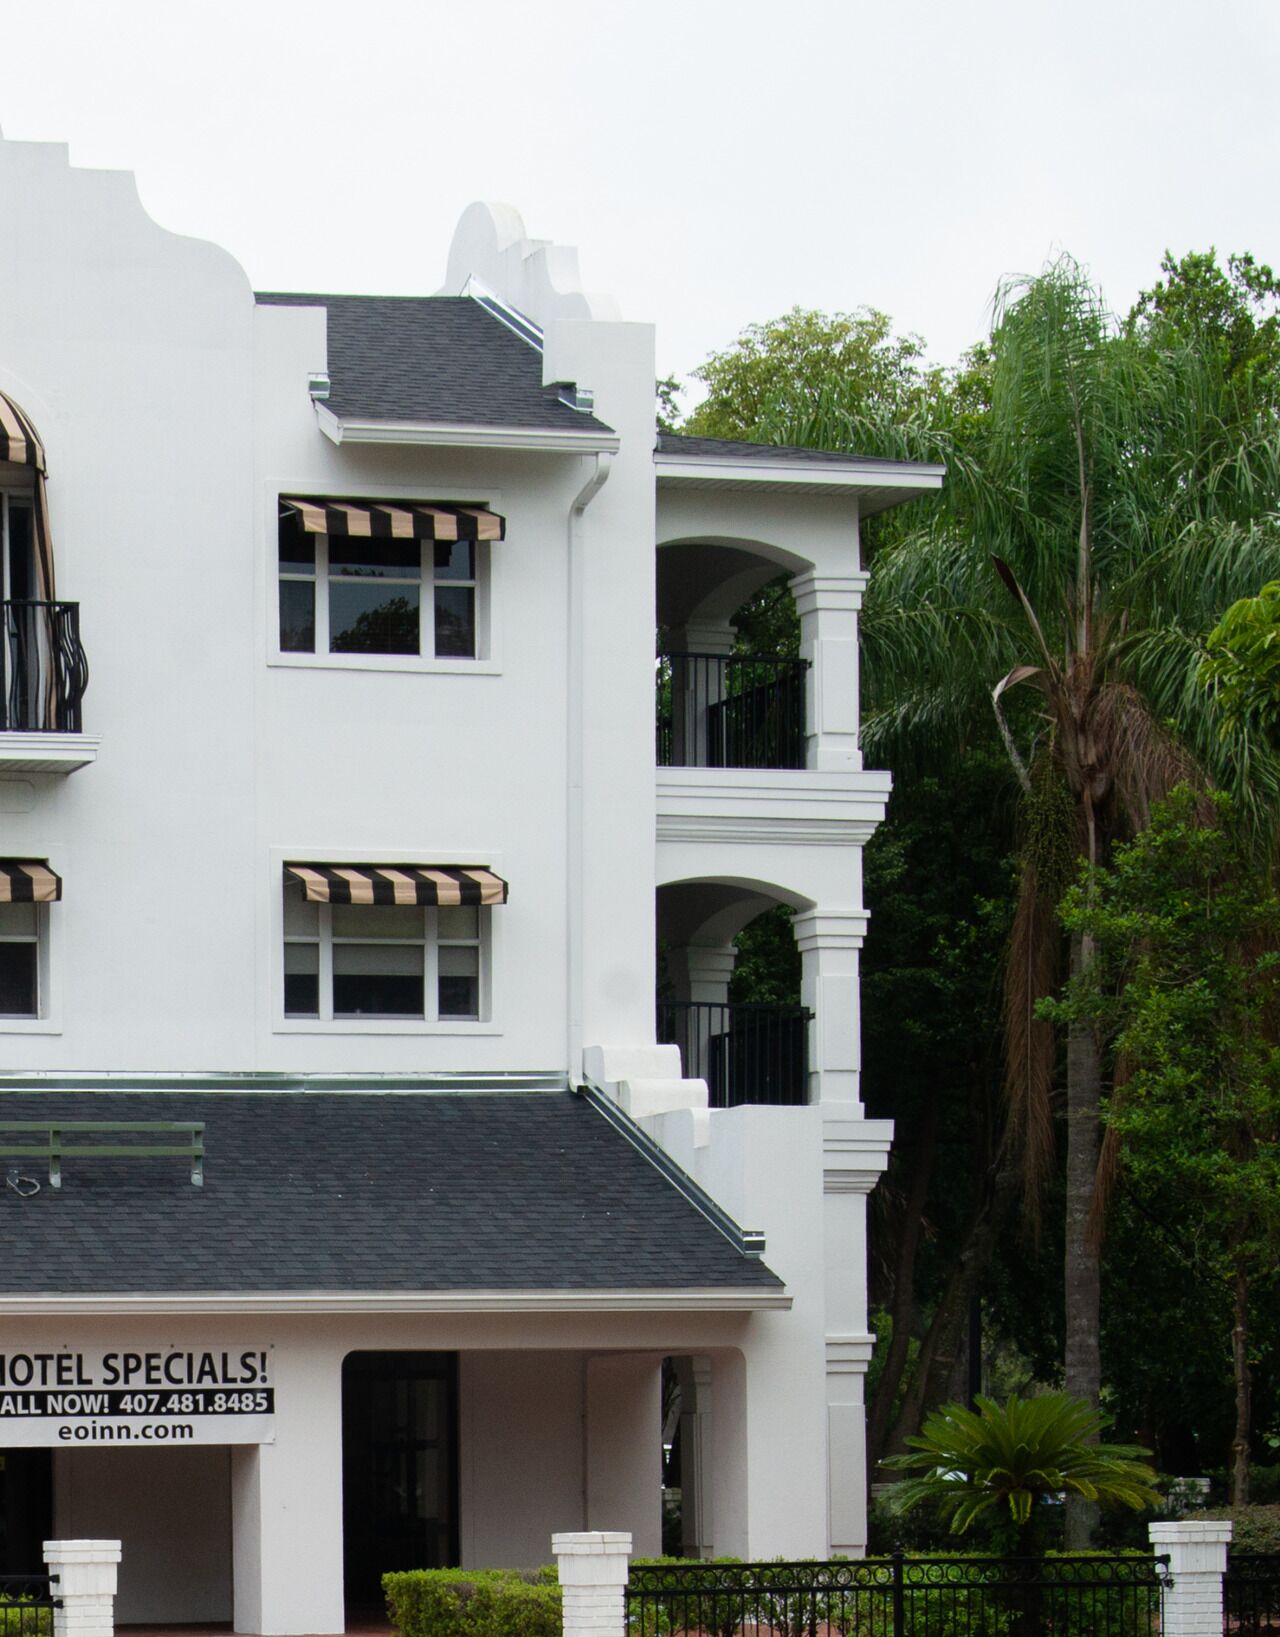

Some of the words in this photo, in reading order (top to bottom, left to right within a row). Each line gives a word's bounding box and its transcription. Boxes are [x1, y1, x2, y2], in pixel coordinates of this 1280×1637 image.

[102, 1352, 268, 1385] SPECIALS!
[47, 1394, 109, 1413] NOW!
[120, 1392, 268, 1413] 407.481.8485
[58, 1420, 193, 1440] eoinn.com
